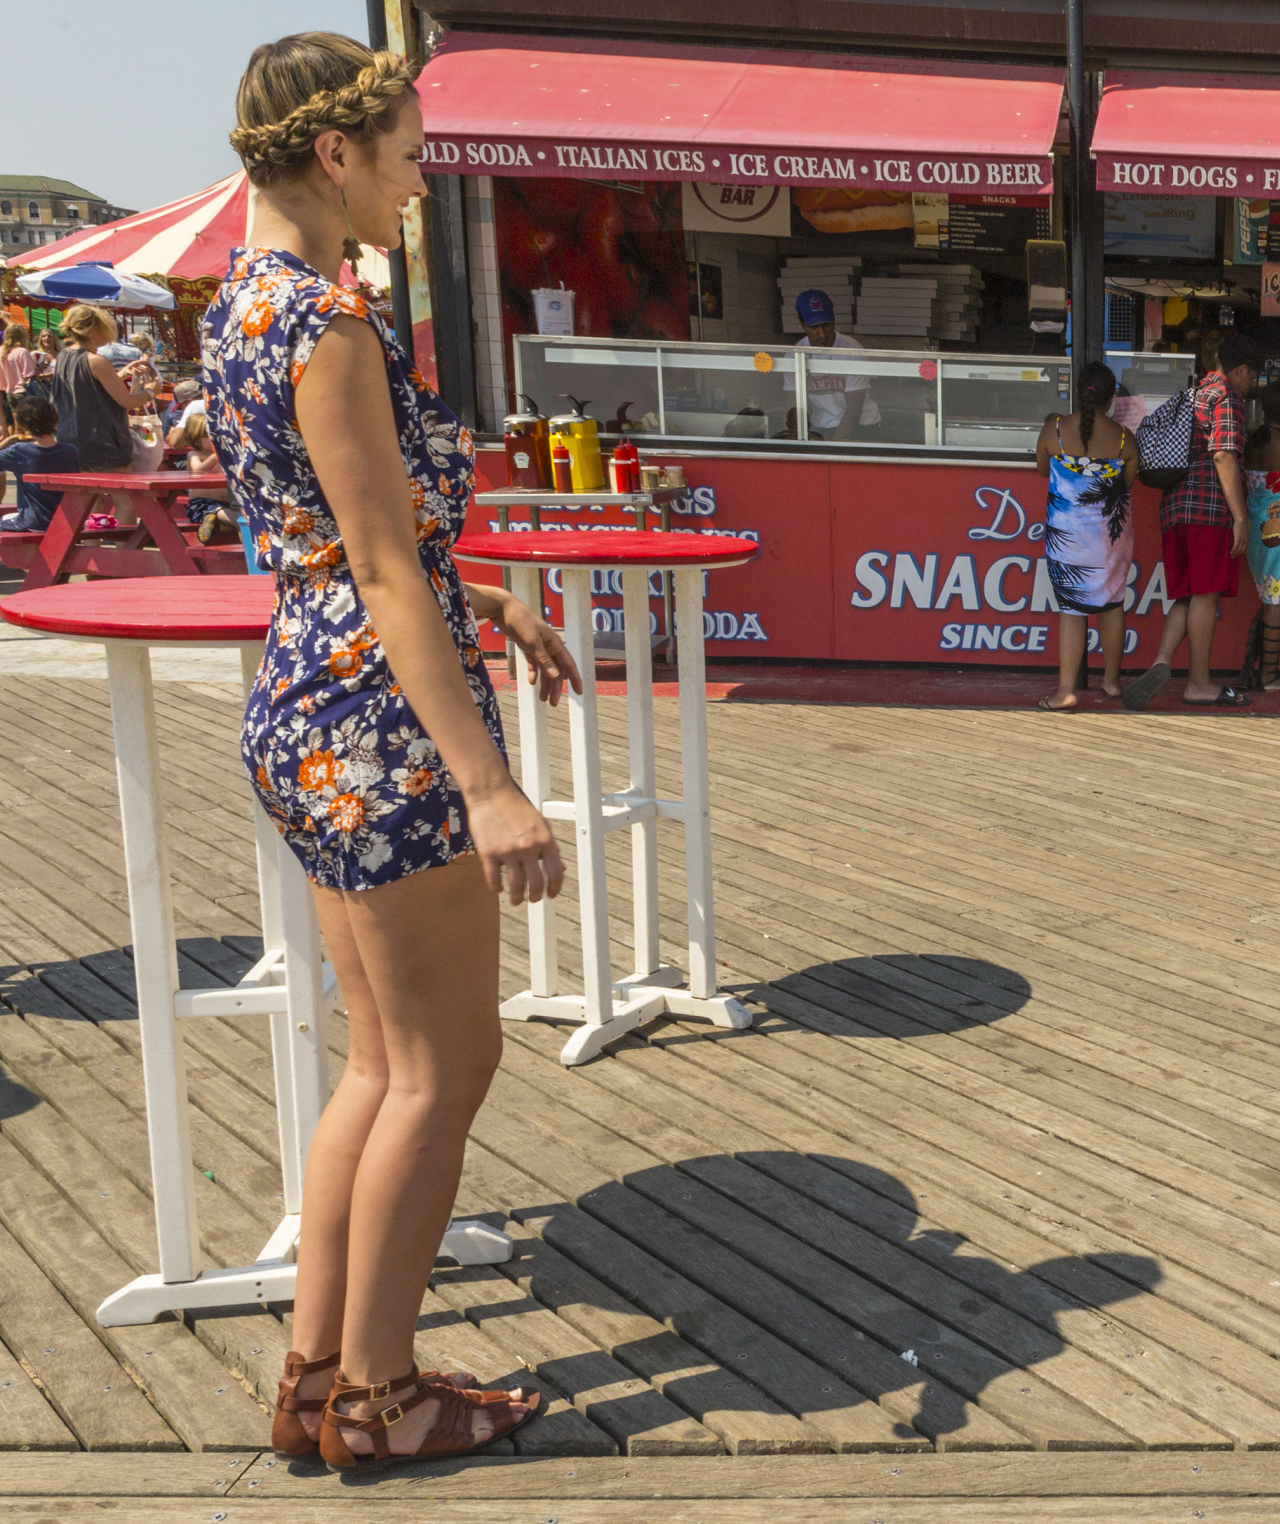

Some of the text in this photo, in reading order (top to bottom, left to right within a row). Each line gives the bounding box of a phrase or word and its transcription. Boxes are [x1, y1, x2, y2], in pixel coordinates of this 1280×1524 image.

[417, 141, 1044, 185] OLD SODA ITALIAN ICES ICE CREAM ICE COLD BEER
[1113, 162, 1165, 186] HOT
[1171, 165, 1238, 189] DOGS
[720, 188, 755, 205] BAR
[982, 195, 1017, 204] SNACKS
[939, 622, 1048, 651] SINCE
